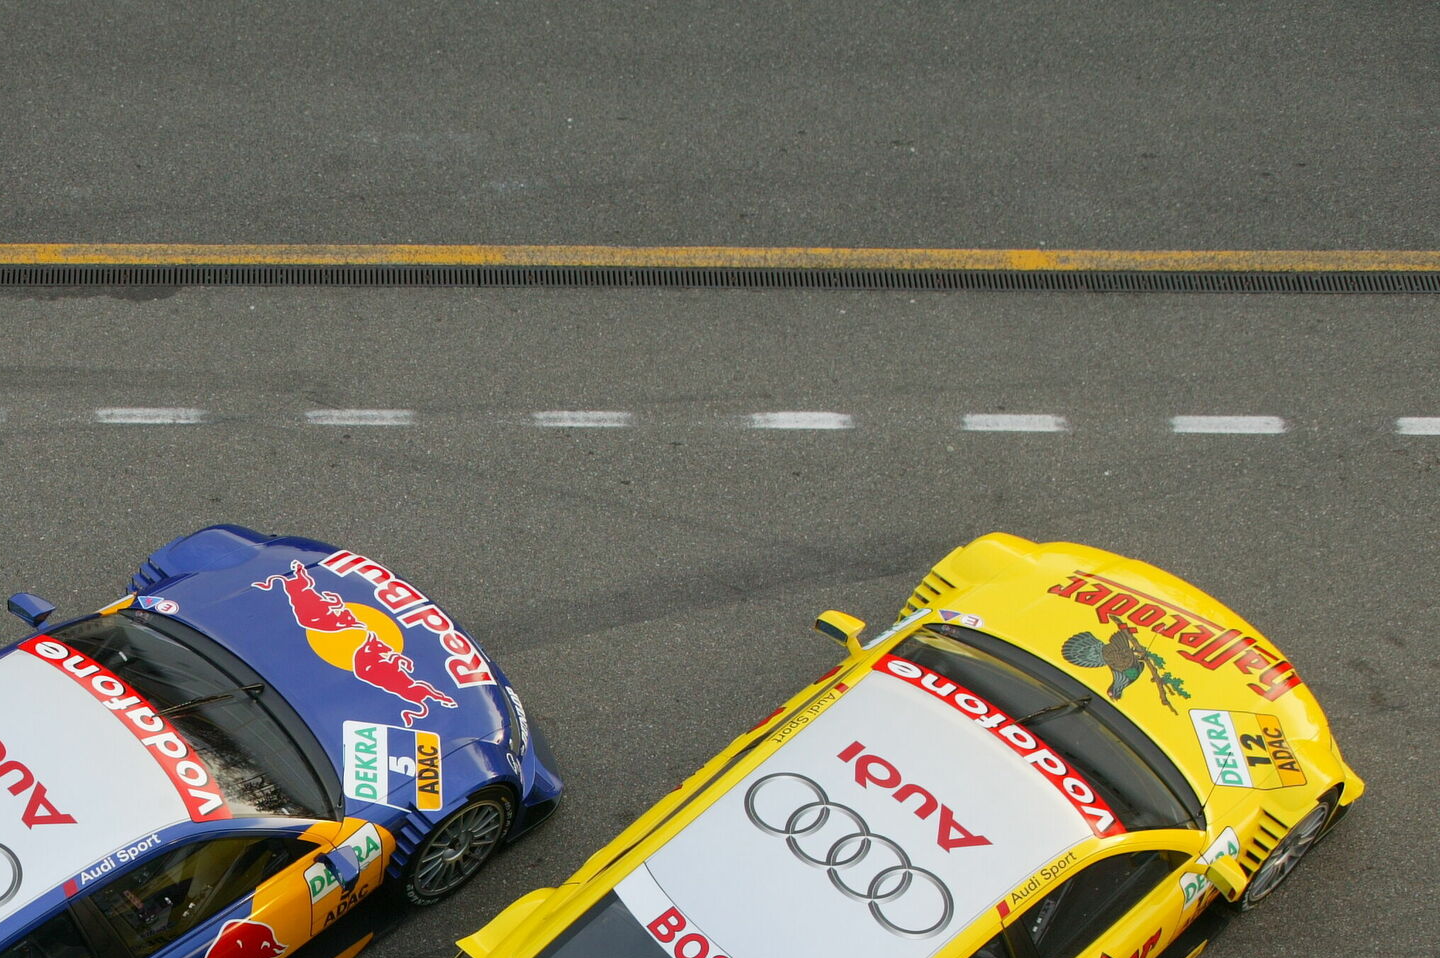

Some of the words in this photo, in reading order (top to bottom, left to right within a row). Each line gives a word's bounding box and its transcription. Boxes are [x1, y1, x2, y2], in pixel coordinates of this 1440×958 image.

[34, 641, 224, 816] vodafone
[772, 715, 810, 743] Sport
[807, 692, 837, 716] Audi
[355, 726, 378, 799] DEKRA
[388, 755, 416, 777] 5
[418, 744, 440, 795] ADAC
[886, 659, 1115, 833] vodafone
[1200, 712, 1244, 785] DEKRA
[1240, 733, 1273, 768] 12
[1263, 727, 1301, 773] ADAC
[836, 740, 994, 854] Audi
[78, 857, 116, 886] Audi
[116, 832, 162, 864] Sport
[1010, 877, 1041, 906] Audi
[1040, 850, 1078, 881] Sport
[323, 883, 369, 927] ADAC
